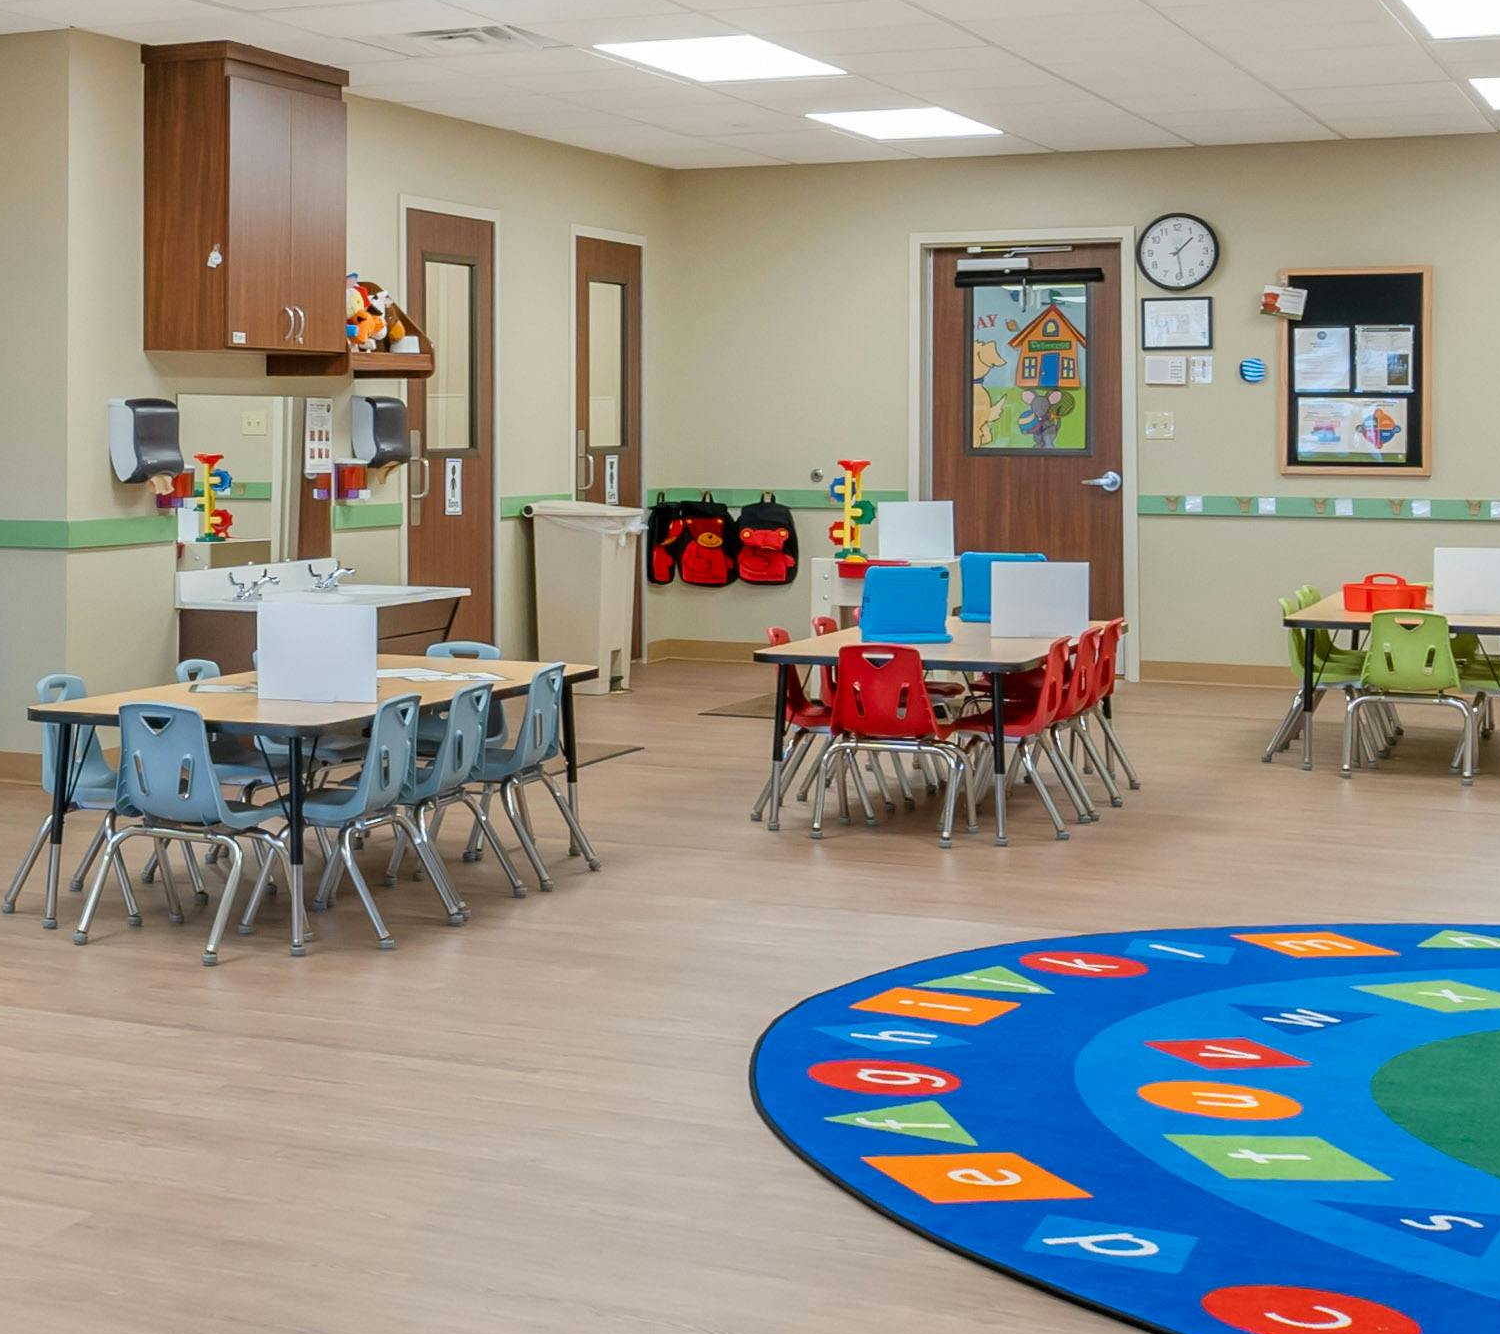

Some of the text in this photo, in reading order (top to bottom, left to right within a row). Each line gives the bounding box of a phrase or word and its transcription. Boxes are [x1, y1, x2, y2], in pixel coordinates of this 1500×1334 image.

[1148, 943, 1206, 959] l
[1271, 933, 1355, 953] m
[1039, 951, 1120, 972] k
[957, 973, 1040, 994] j
[1419, 987, 1483, 1004] x
[898, 999, 973, 1013] i
[1262, 1007, 1341, 1030] w
[850, 1027, 939, 1045] h
[1196, 1043, 1263, 1062] v
[855, 1067, 947, 1089] g
[1192, 1089, 1261, 1108] u
[854, 1114, 953, 1131] f
[1226, 1145, 1312, 1164] t
[946, 1167, 1022, 1187] e
[1400, 1212, 1484, 1235] s
[1042, 1231, 1161, 1258] d
[1264, 1305, 1353, 1330] c
